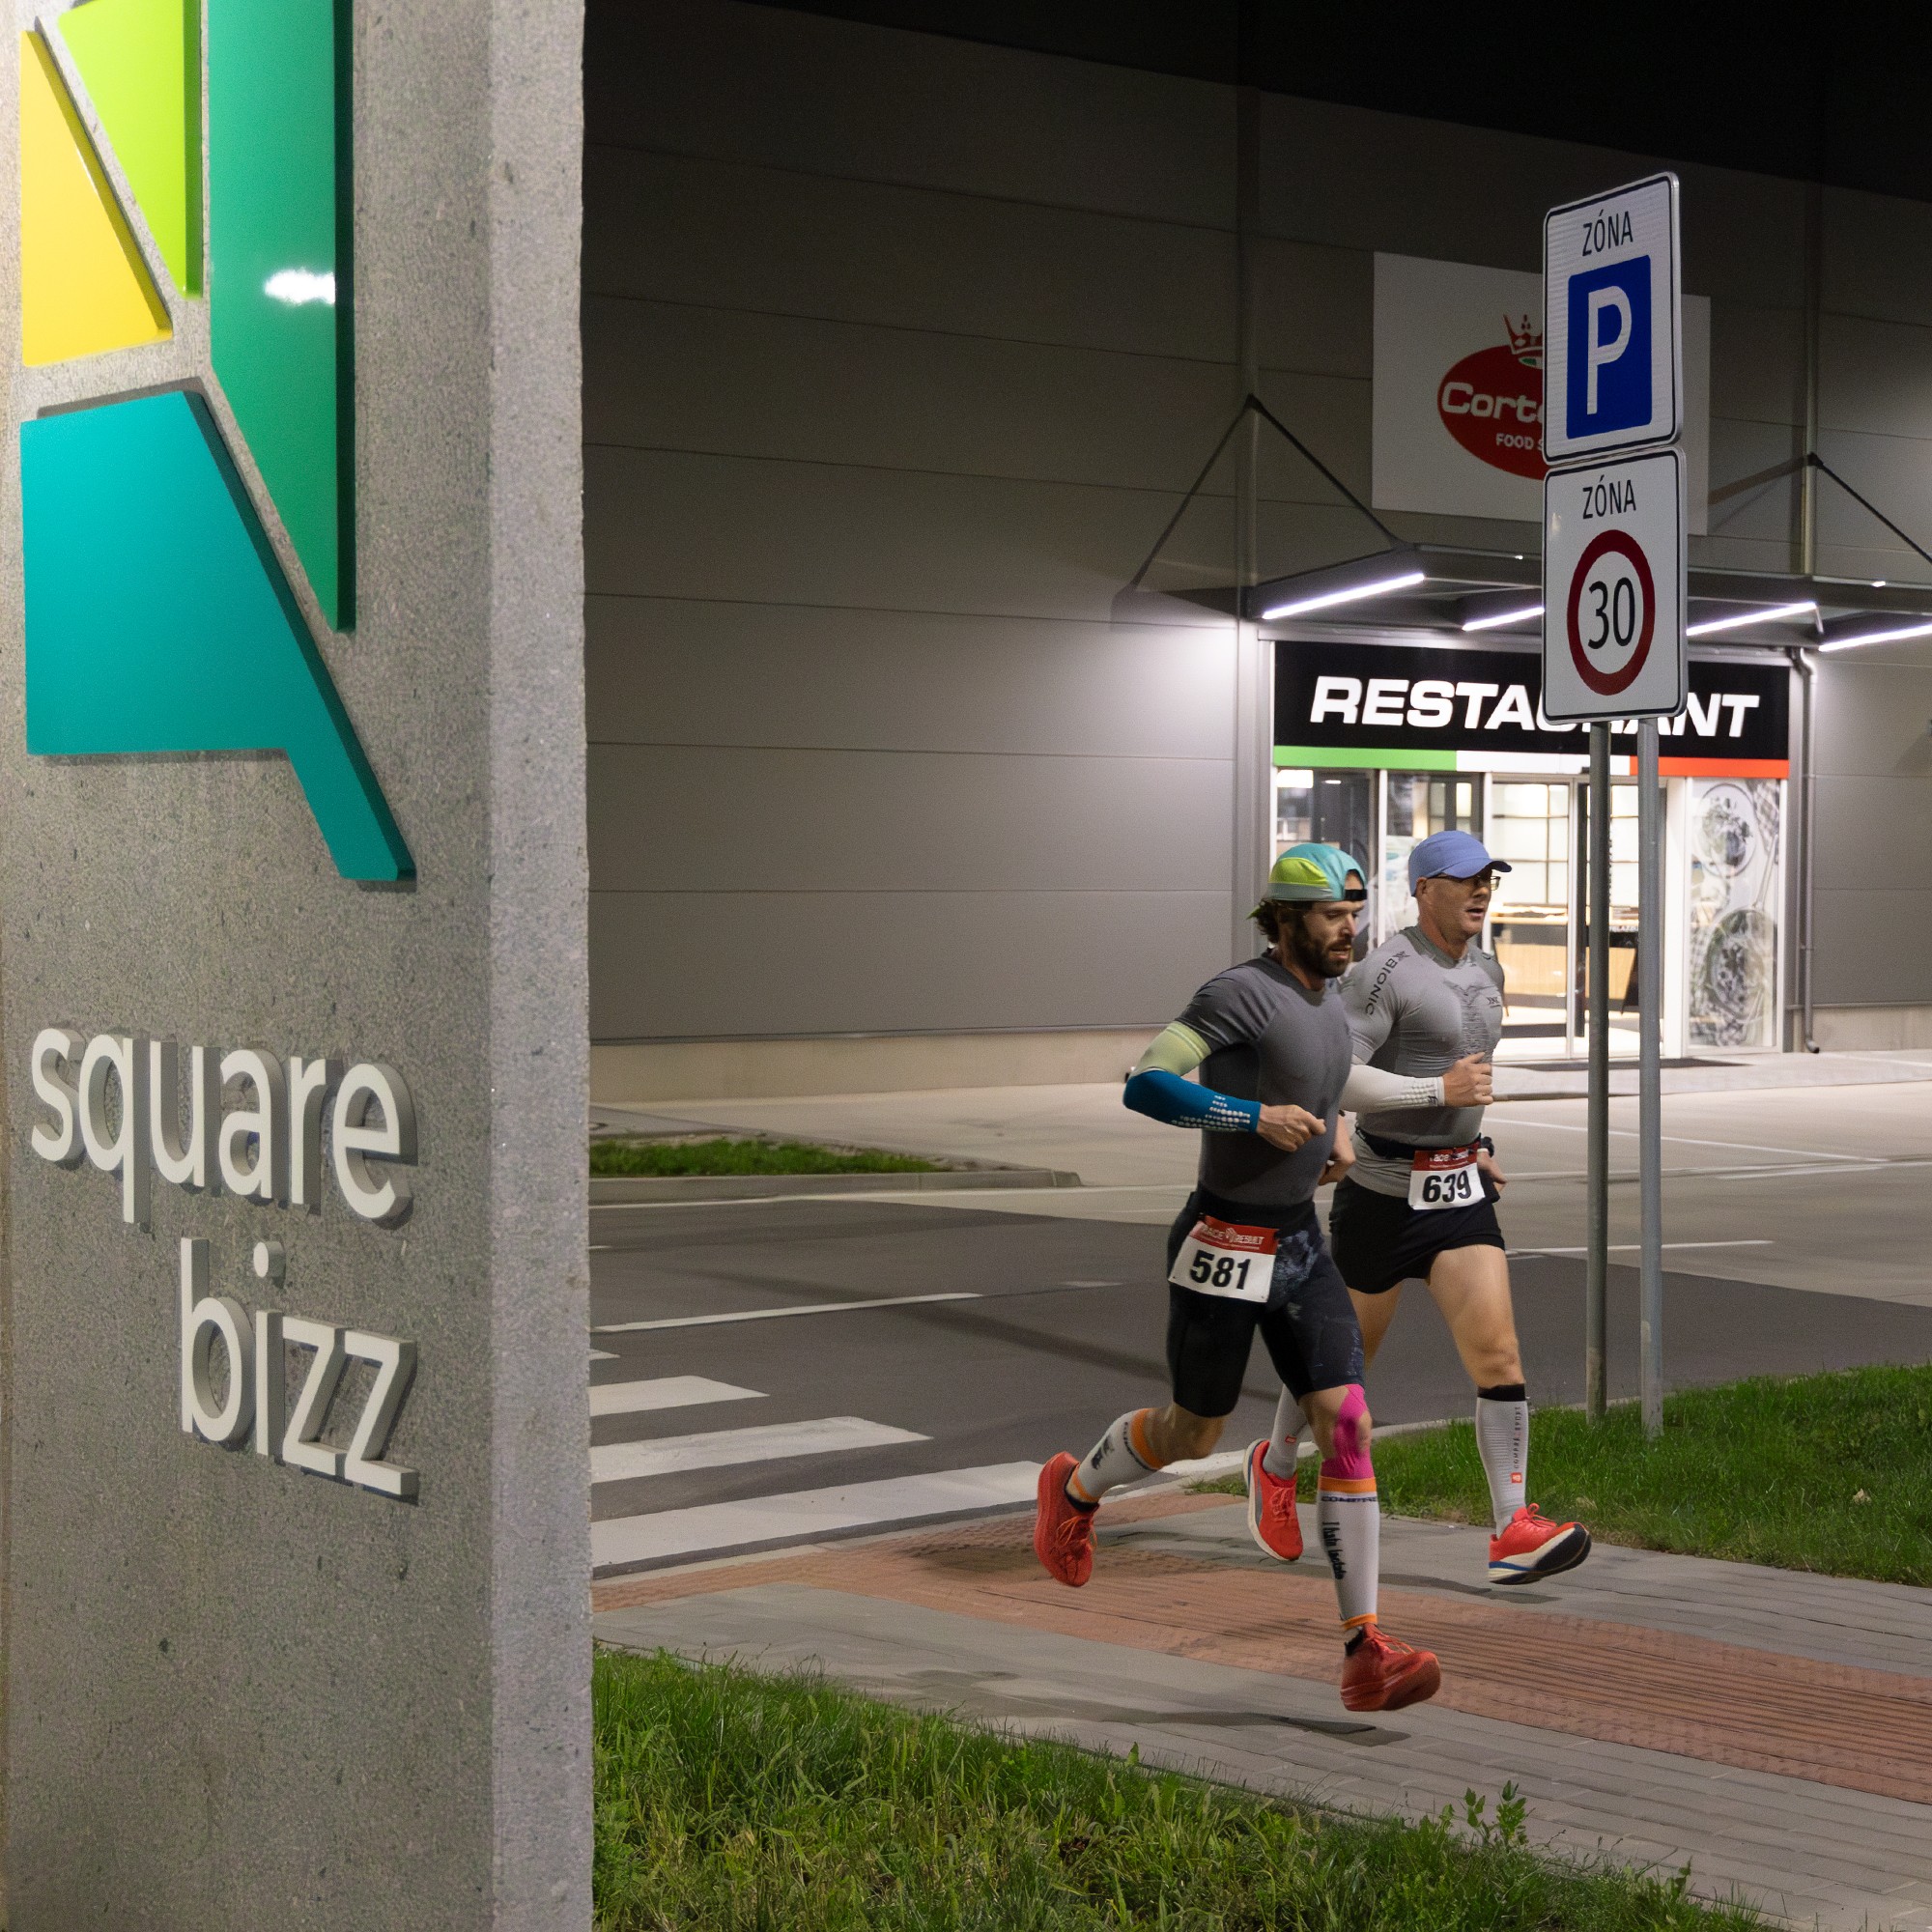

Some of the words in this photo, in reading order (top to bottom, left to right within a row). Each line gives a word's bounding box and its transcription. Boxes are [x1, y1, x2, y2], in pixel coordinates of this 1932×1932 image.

[1581, 209, 1634, 257] ZÓNA
[1586, 286, 1633, 415] P
[1495, 433, 1534, 450] FOOD
[1581, 479, 1637, 520] ZÓNA
[1587, 577, 1636, 650] 30
[1310, 675, 1760, 737] RESTANT
[31, 1028, 417, 1225] square
[1422, 1170, 1472, 1203] 639
[1190, 1250, 1251, 1290] 581
[181, 1236, 417, 1496] bizz
